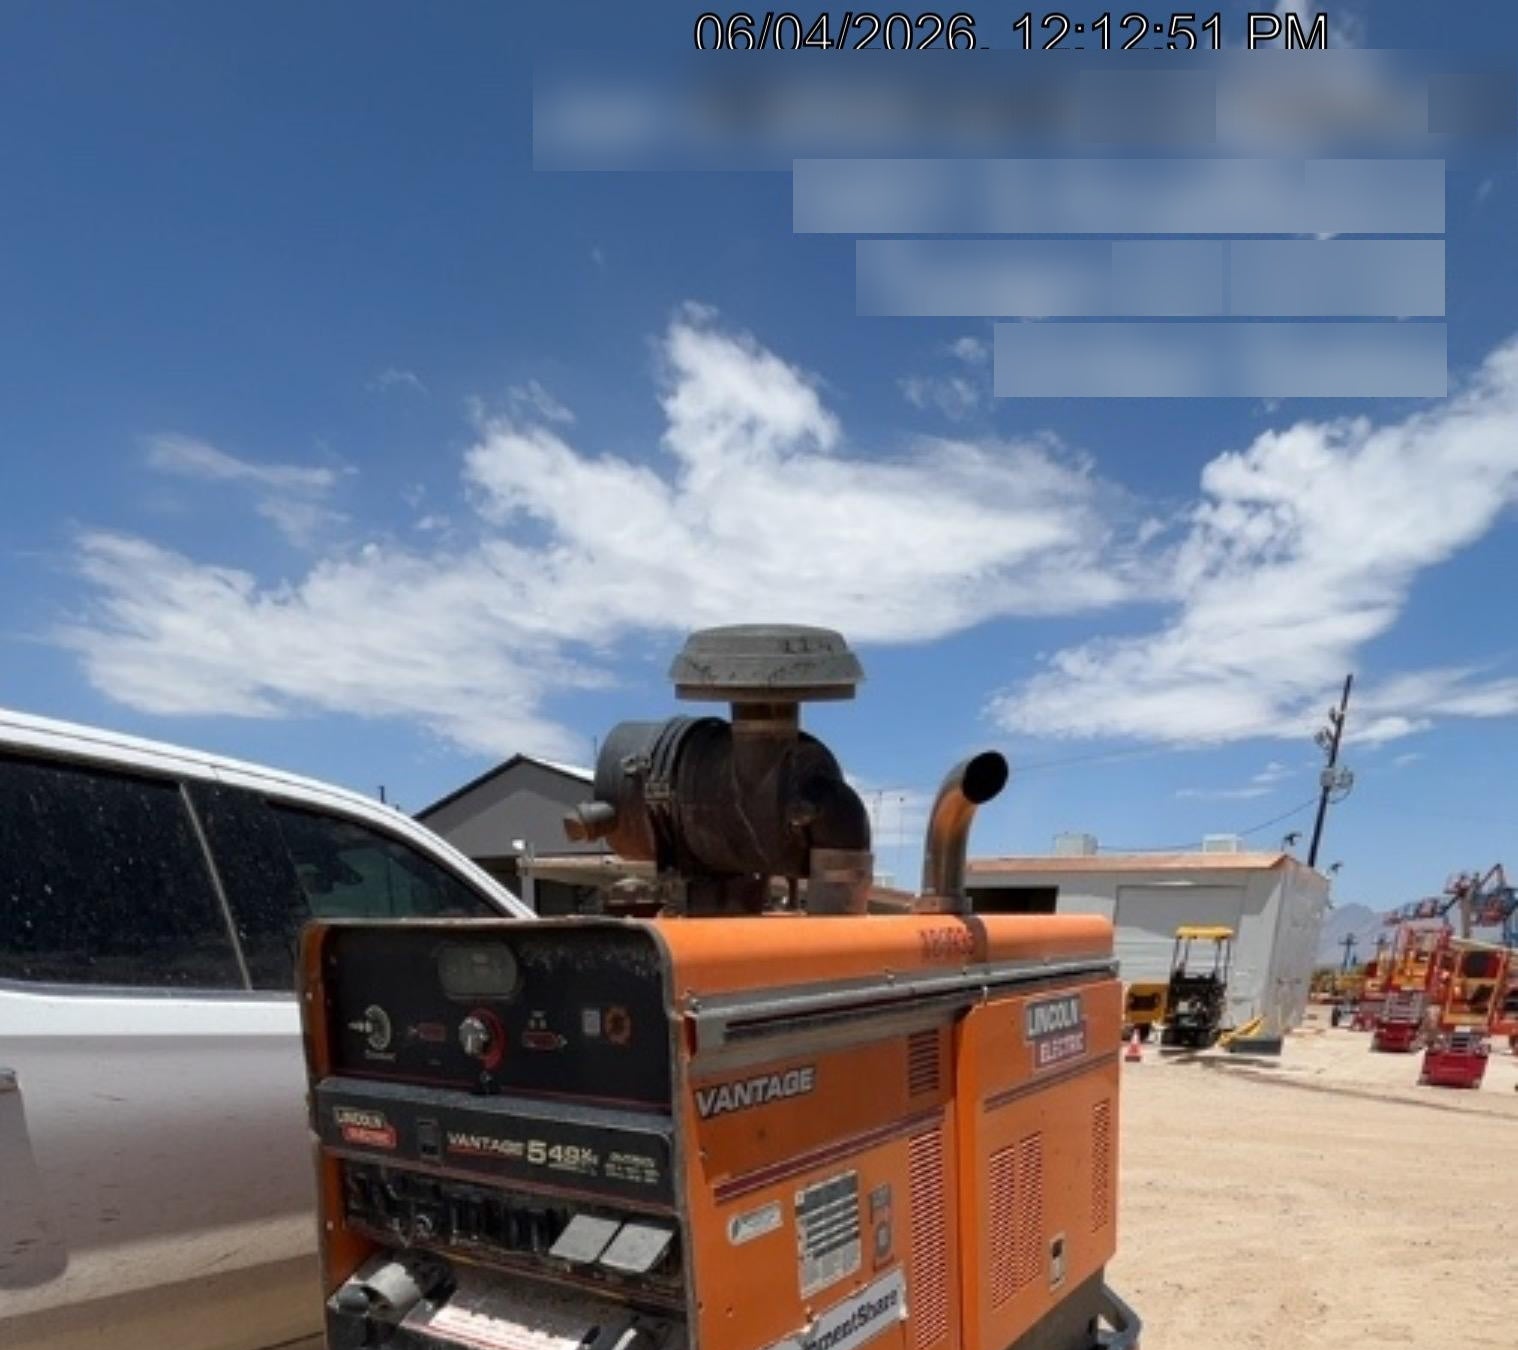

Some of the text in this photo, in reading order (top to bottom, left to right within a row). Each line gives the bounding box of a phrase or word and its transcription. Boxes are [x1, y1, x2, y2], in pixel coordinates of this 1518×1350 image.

[1028, 999, 1078, 1036] LINCOLN
[695, 1066, 815, 1118] VANTAGE
[447, 1131, 525, 1157] VANTAGE
